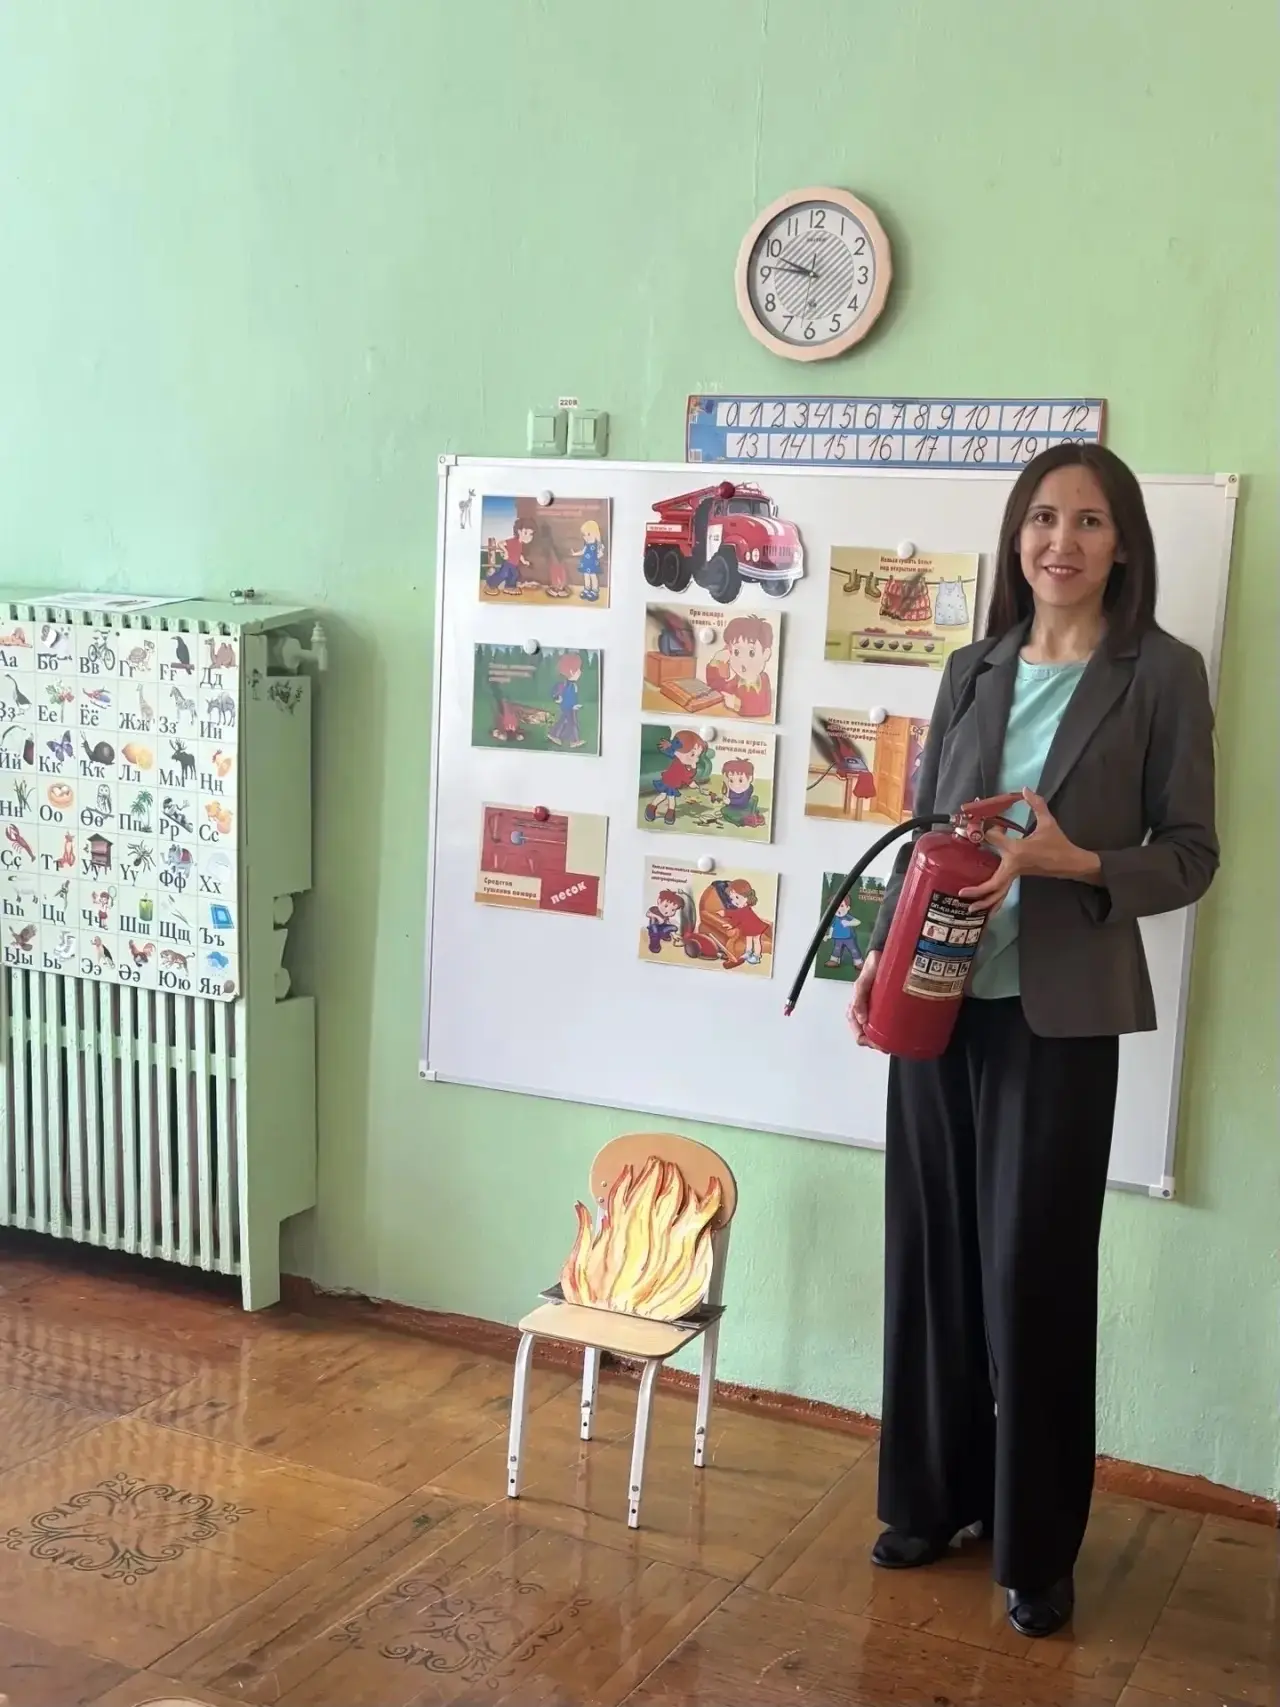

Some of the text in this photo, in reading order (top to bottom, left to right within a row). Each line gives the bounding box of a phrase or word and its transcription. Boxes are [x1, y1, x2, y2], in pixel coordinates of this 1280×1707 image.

[787, 217, 799, 236] 11
[810, 210, 826, 229] 12
[840, 217, 845, 236] 1
[766, 239, 782, 258] 10
[853, 237, 866, 256] 2
[760, 265, 772, 284] 9
[857, 266, 869, 285] 3
[765, 293, 776, 312] 8
[847, 294, 858, 312] 4
[782, 315, 794, 333] 7
[804, 321, 816, 340] 6
[829, 314, 841, 332] 5
[726, 402, 1090, 432] 0 1 2 3 4 5 6 7 8 9 10 11 12
[736, 433, 1038, 464] 13 14 15 16 17 18 19
[0, 650, 18, 668] Аа
[37, 653, 59, 671] Бб
[80, 657, 100, 675] Вв
[119, 660, 136, 678] Гг
[199, 667, 223, 690] Дд
[38, 704, 58, 722] Ее
[80, 704, 99, 726] Ёё
[119, 712, 150, 732] Жж
[159, 715, 177, 734] Зз
[200, 720, 222, 739] Ии
[0, 747, 21, 770] Йй
[39, 755, 61, 774] Кк
[119, 765, 141, 783] Лл
[159, 768, 186, 788] Мм
[0, 800, 23, 818] Нн
[39, 804, 63, 823] Оо
[119, 813, 142, 831] Пп
[159, 818, 180, 841] Рр
[199, 824, 219, 842] Сс
[40, 853, 63, 872] Тт
[82, 858, 99, 881] Уу
[159, 870, 186, 893] Фф
[199, 875, 222, 894] Хх
[42, 904, 66, 925] Цц
[82, 909, 103, 929] Чч
[120, 914, 150, 935] Шш
[159, 921, 191, 945] Щщ
[199, 927, 225, 947] Ъъ
[5, 946, 33, 966] Ыы
[43, 952, 62, 970] Ьь
[81, 957, 102, 976] Ээ
[159, 970, 191, 991] Юю
[200, 978, 221, 996] Яя
